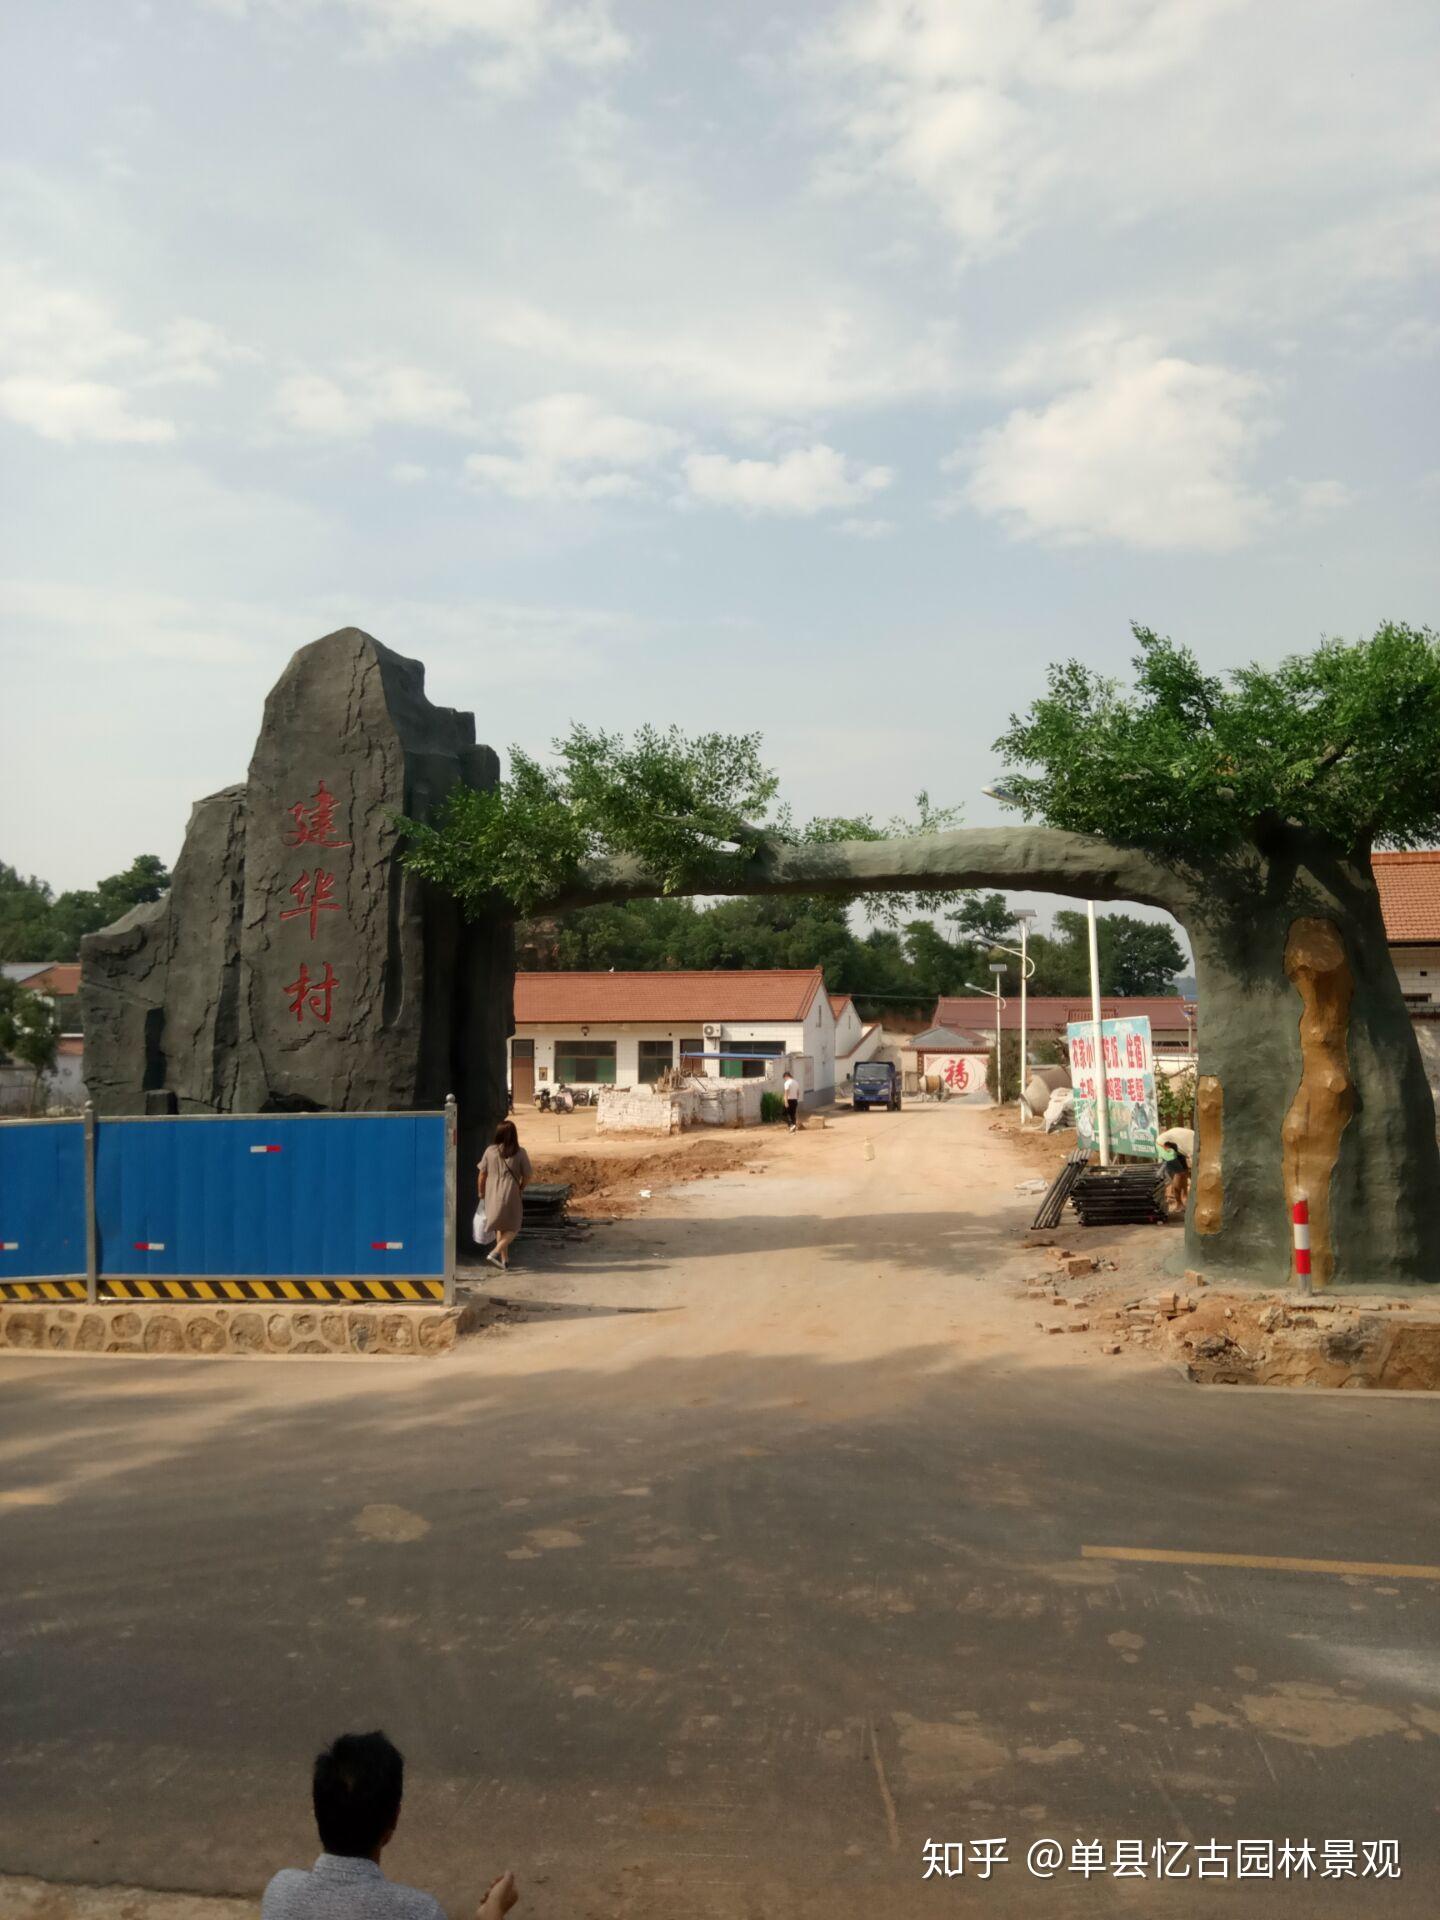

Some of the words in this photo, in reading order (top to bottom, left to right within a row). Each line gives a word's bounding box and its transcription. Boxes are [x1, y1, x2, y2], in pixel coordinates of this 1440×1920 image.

[279, 779, 352, 1025] 建华村
[944, 1058, 969, 1090] 福
